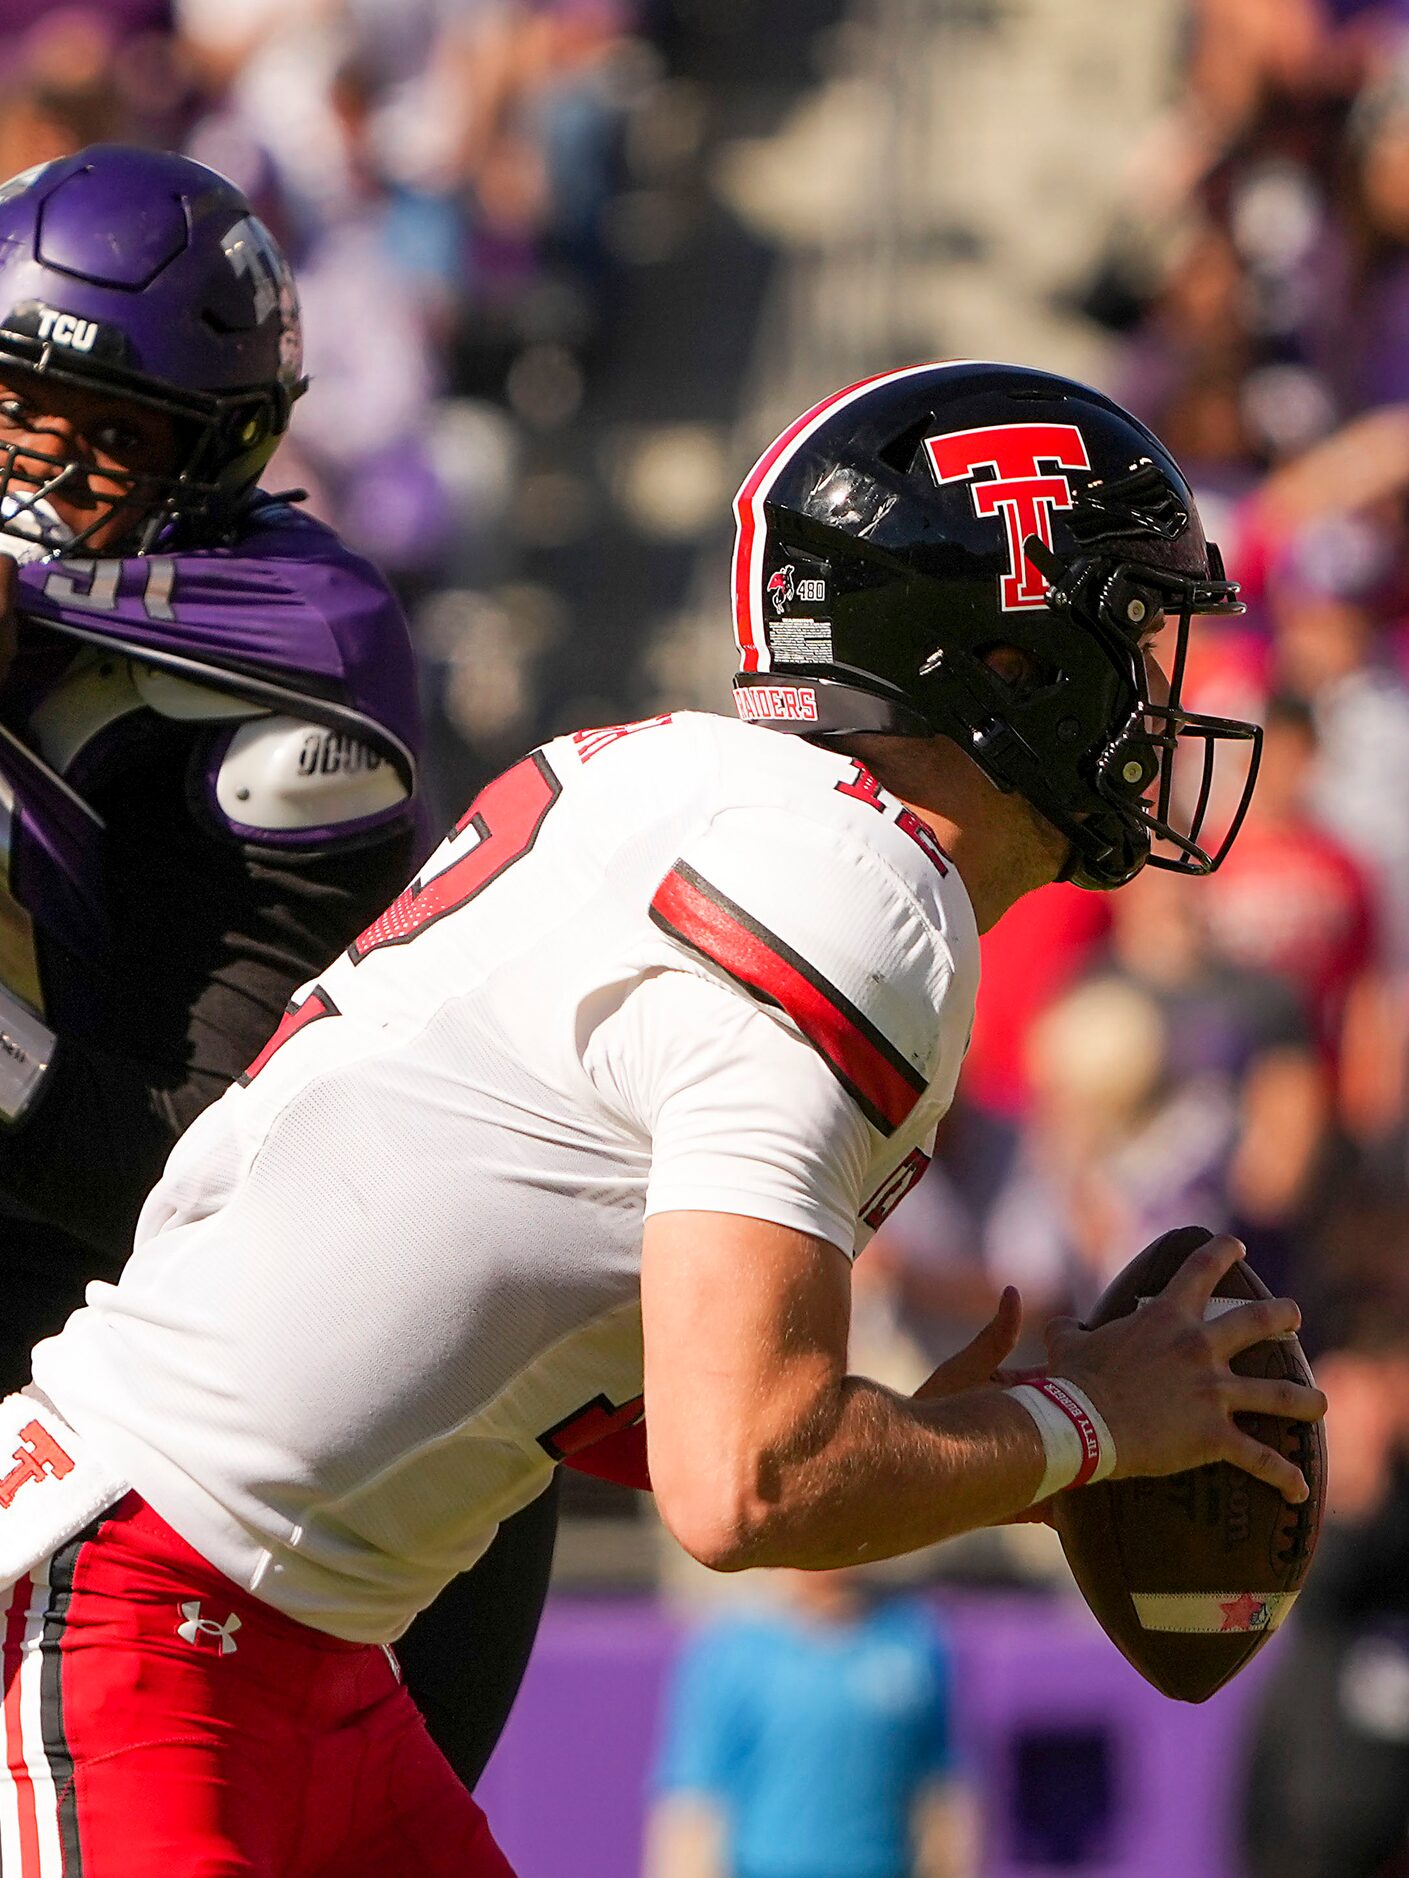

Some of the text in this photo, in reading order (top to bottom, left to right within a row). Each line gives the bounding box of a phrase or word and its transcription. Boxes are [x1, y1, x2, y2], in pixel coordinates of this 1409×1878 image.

[38, 309, 98, 351] TCU
[796, 580, 825, 601] 480
[1077, 1419, 1098, 1459] FIFTY
